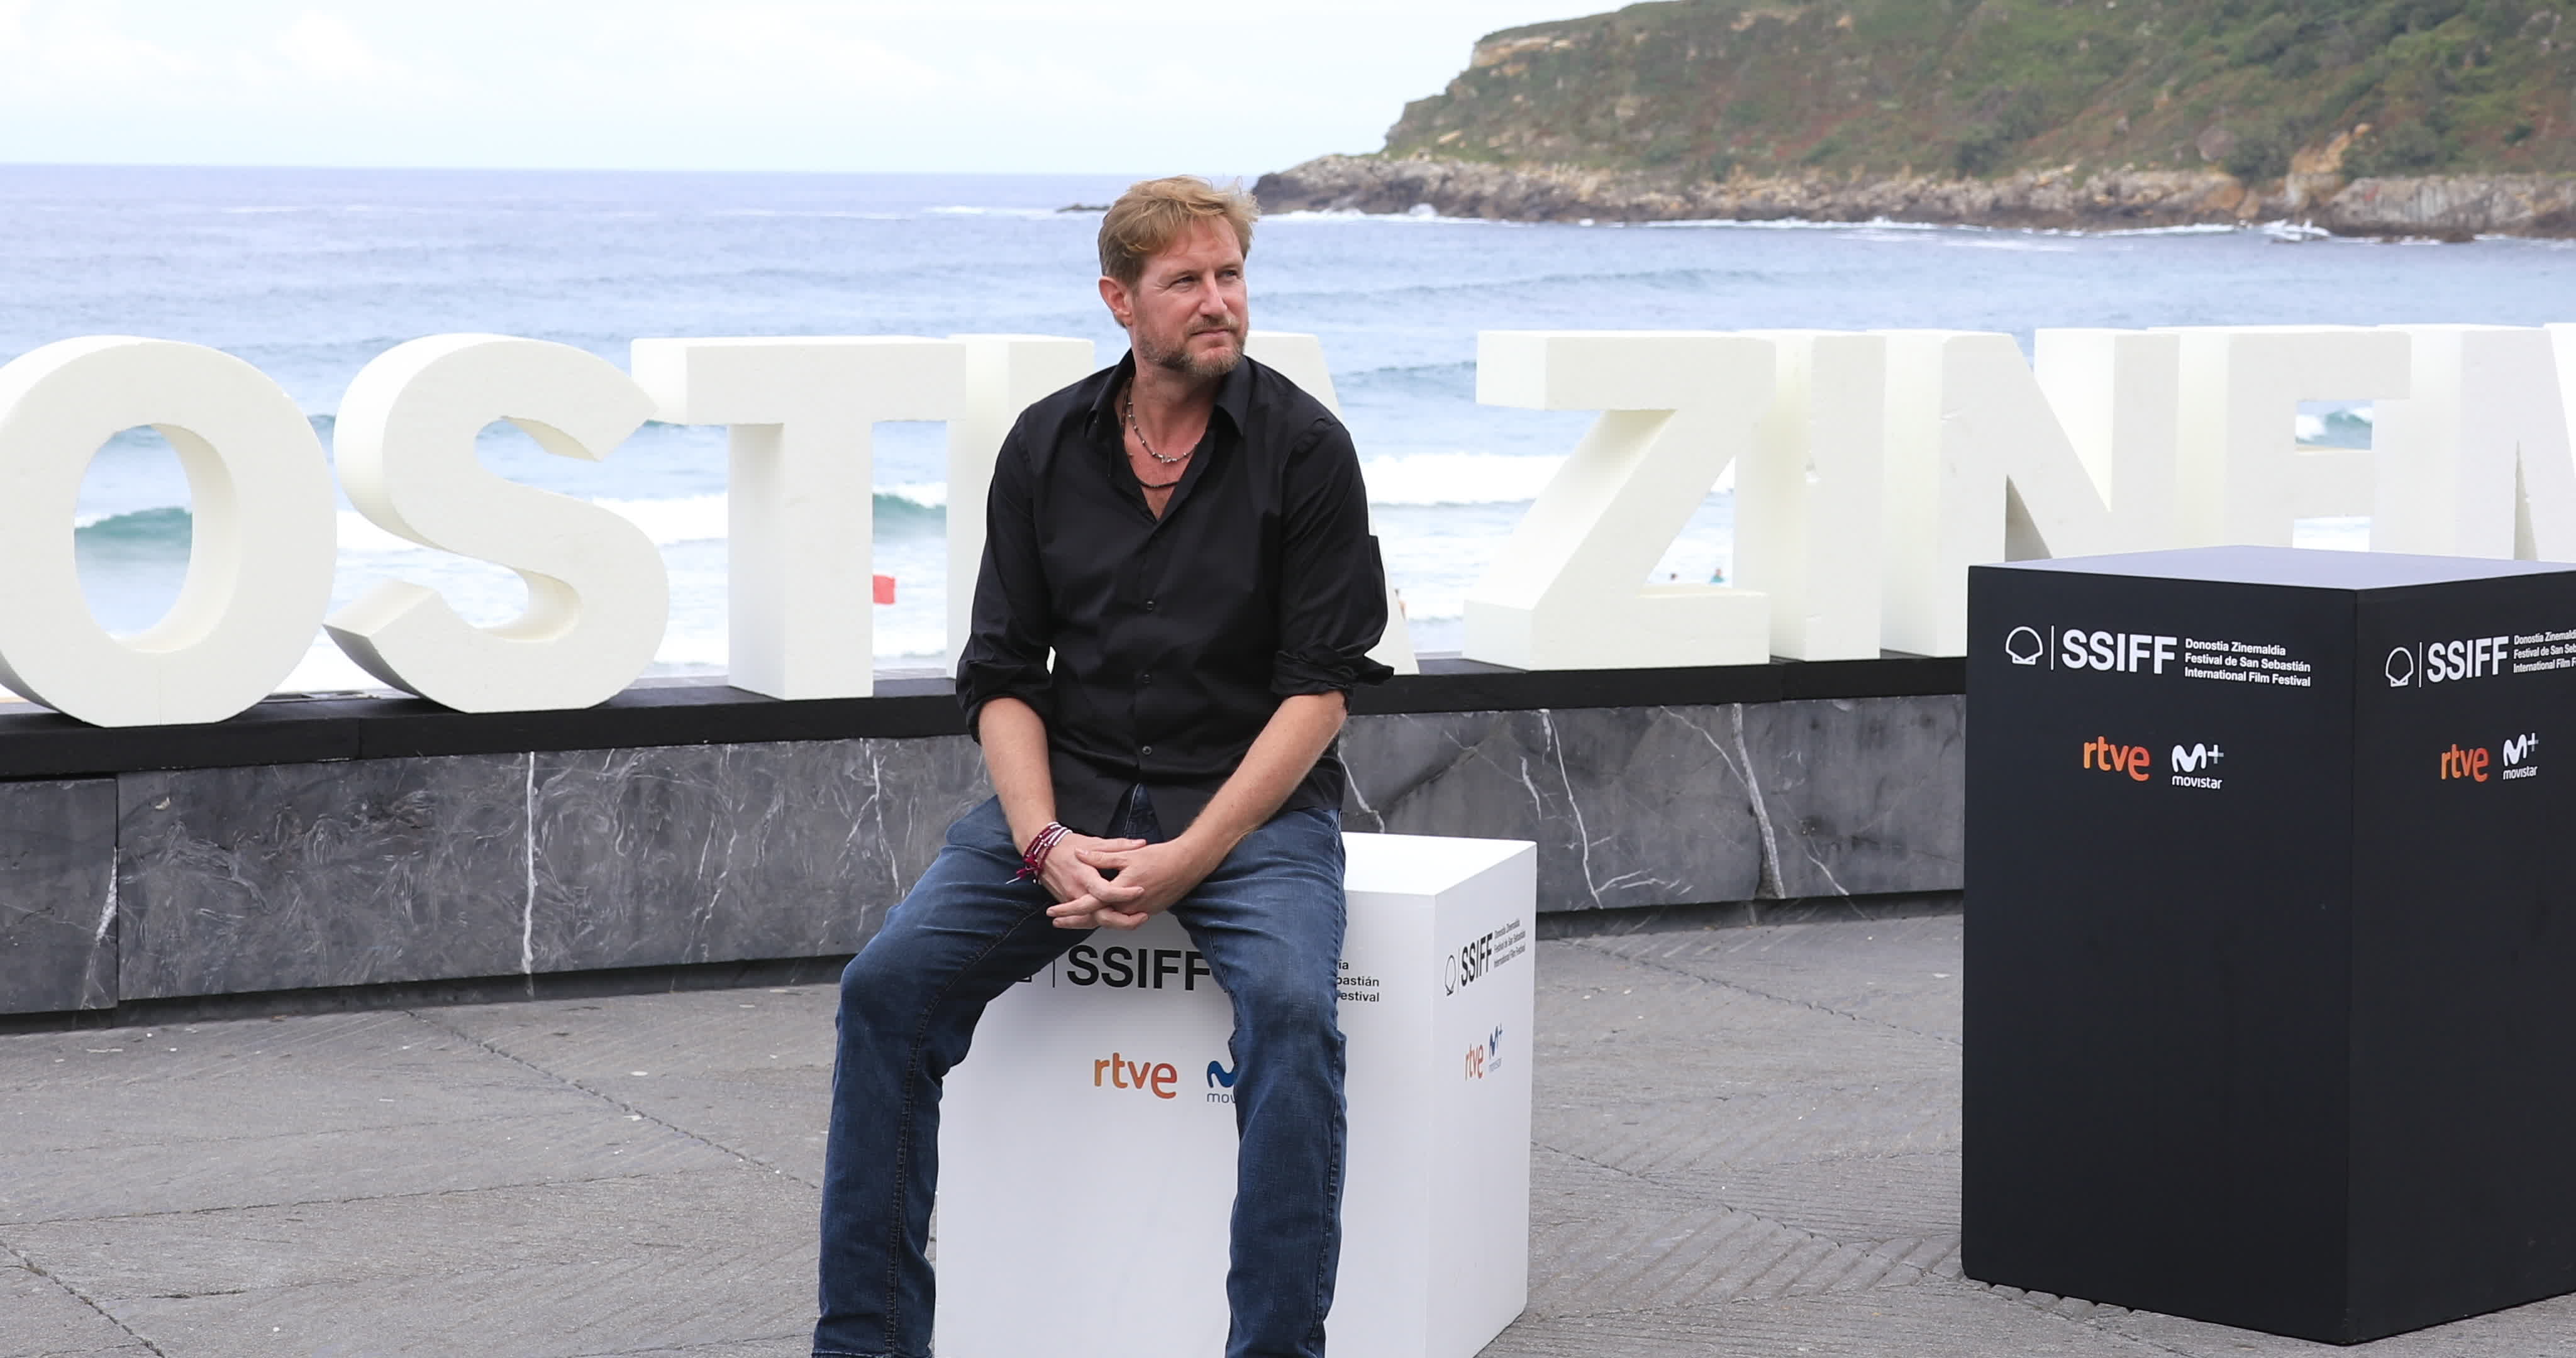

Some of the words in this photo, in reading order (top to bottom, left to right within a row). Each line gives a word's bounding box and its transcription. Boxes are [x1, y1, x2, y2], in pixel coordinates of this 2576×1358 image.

[2185, 638, 2229, 651] Donostia
[2231, 641, 2287, 656] Zinemaldia
[2514, 632, 2544, 645] Donostia
[2061, 628, 2178, 675] SSIFF
[2184, 652, 2223, 665] Festival
[2225, 656, 2238, 666] de
[2240, 656, 2259, 668] San
[2261, 658, 2311, 672] Sebastián
[2426, 636, 2509, 683] SSIFF
[2513, 646, 2540, 660] Festival
[2541, 646, 2550, 656] de
[2550, 645, 2563, 655] San
[2513, 659, 2555, 673] International
[2557, 658, 2570, 669] Film
[2184, 666, 2246, 682] International
[2248, 671, 2270, 683] Film
[2272, 673, 2311, 687] Festival
[2083, 736, 2150, 781] rtve
[2440, 743, 2489, 782] rtve
[2172, 775, 2223, 790] movistar
[2502, 765, 2538, 780] movistar
[1067, 944, 1211, 991] SSIFF
[1460, 932, 1493, 987] SSIFF
[1340, 991, 1380, 1003] estival
[1465, 1042, 1484, 1081] rtve
[1094, 1052, 1177, 1099] rtve
